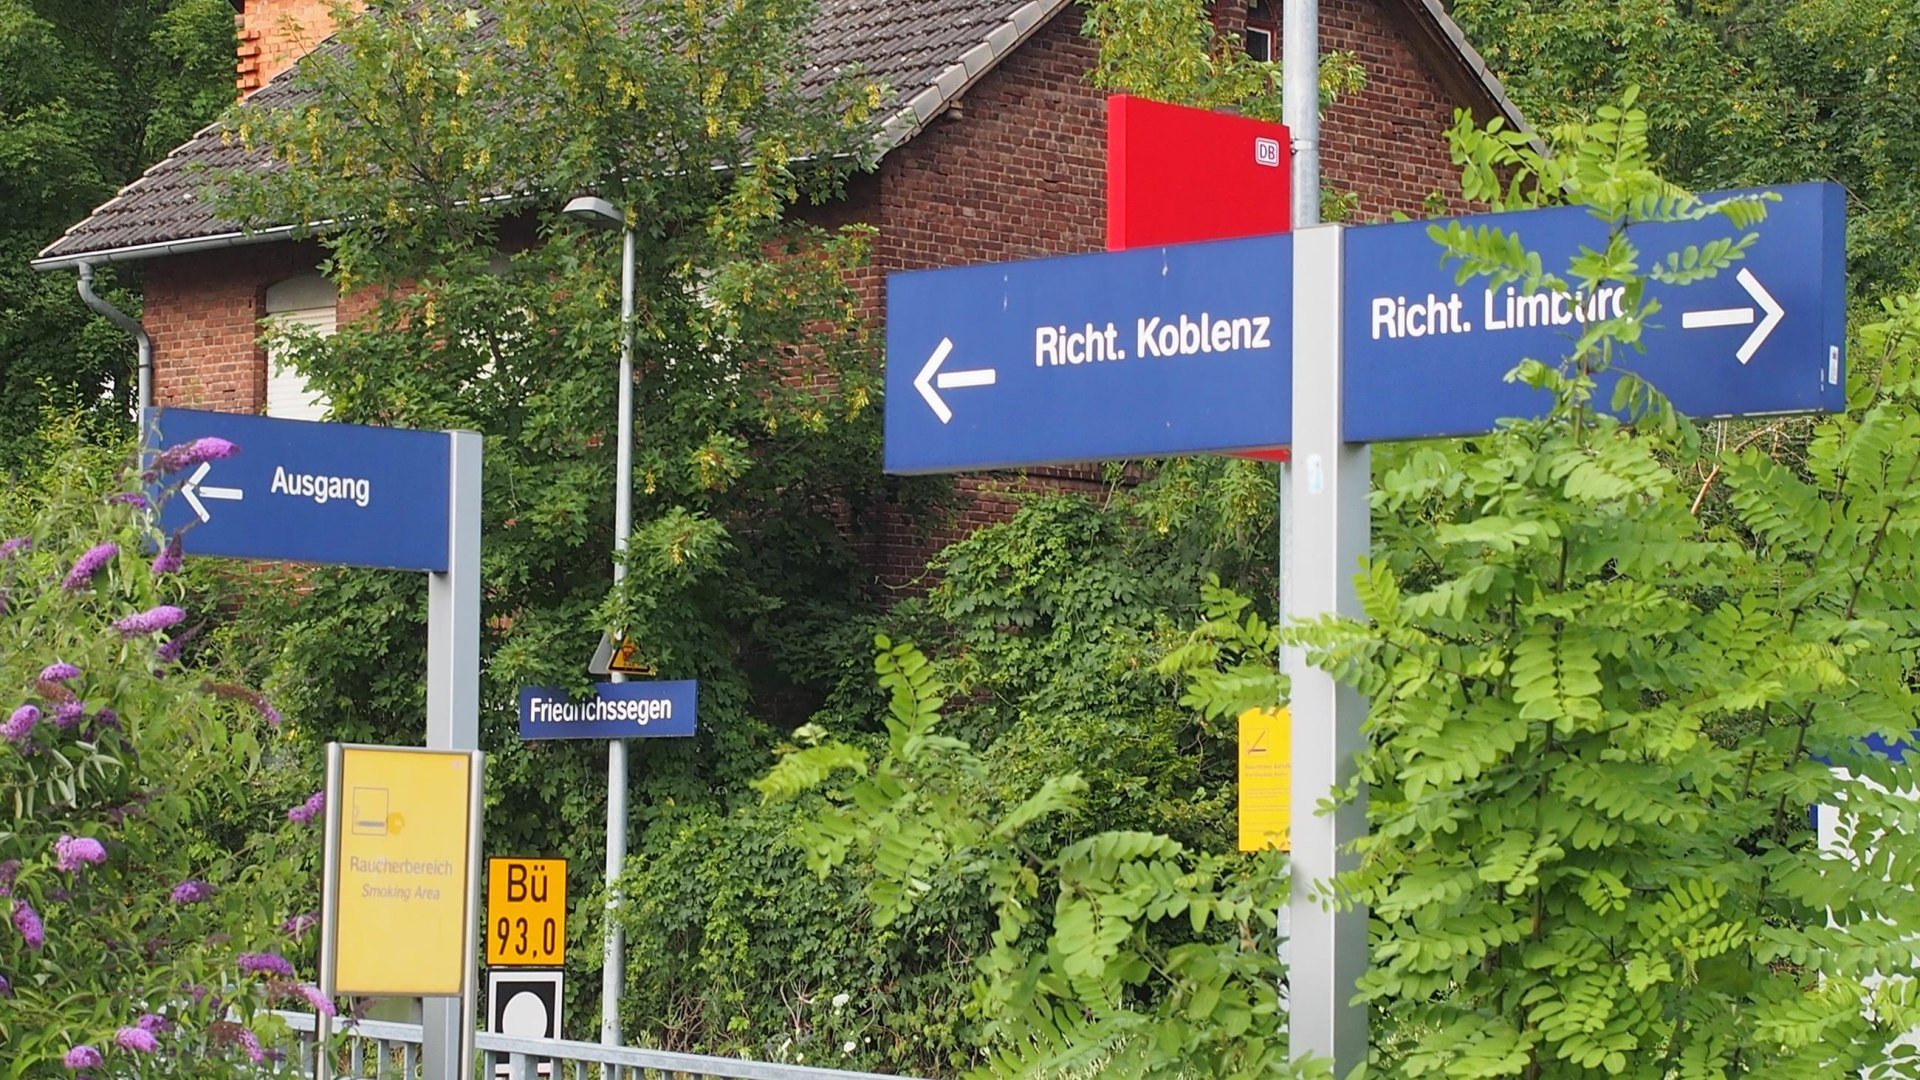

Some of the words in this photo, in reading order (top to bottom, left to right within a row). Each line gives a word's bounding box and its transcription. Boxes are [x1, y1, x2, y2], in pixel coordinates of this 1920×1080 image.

[1259, 143, 1276, 161] DB
[1371, 293, 1471, 341] Richt.
[1035, 322, 1126, 367] Richt.
[1137, 312, 1271, 359] Koblenz
[270, 466, 370, 507] Ausgang
[350, 855, 453, 876] Raucherbereich
[507, 863, 548, 903] Bü
[361, 883, 412, 902] Smoking
[414, 886, 441, 901] Area
[497, 917, 556, 958] 93,0
